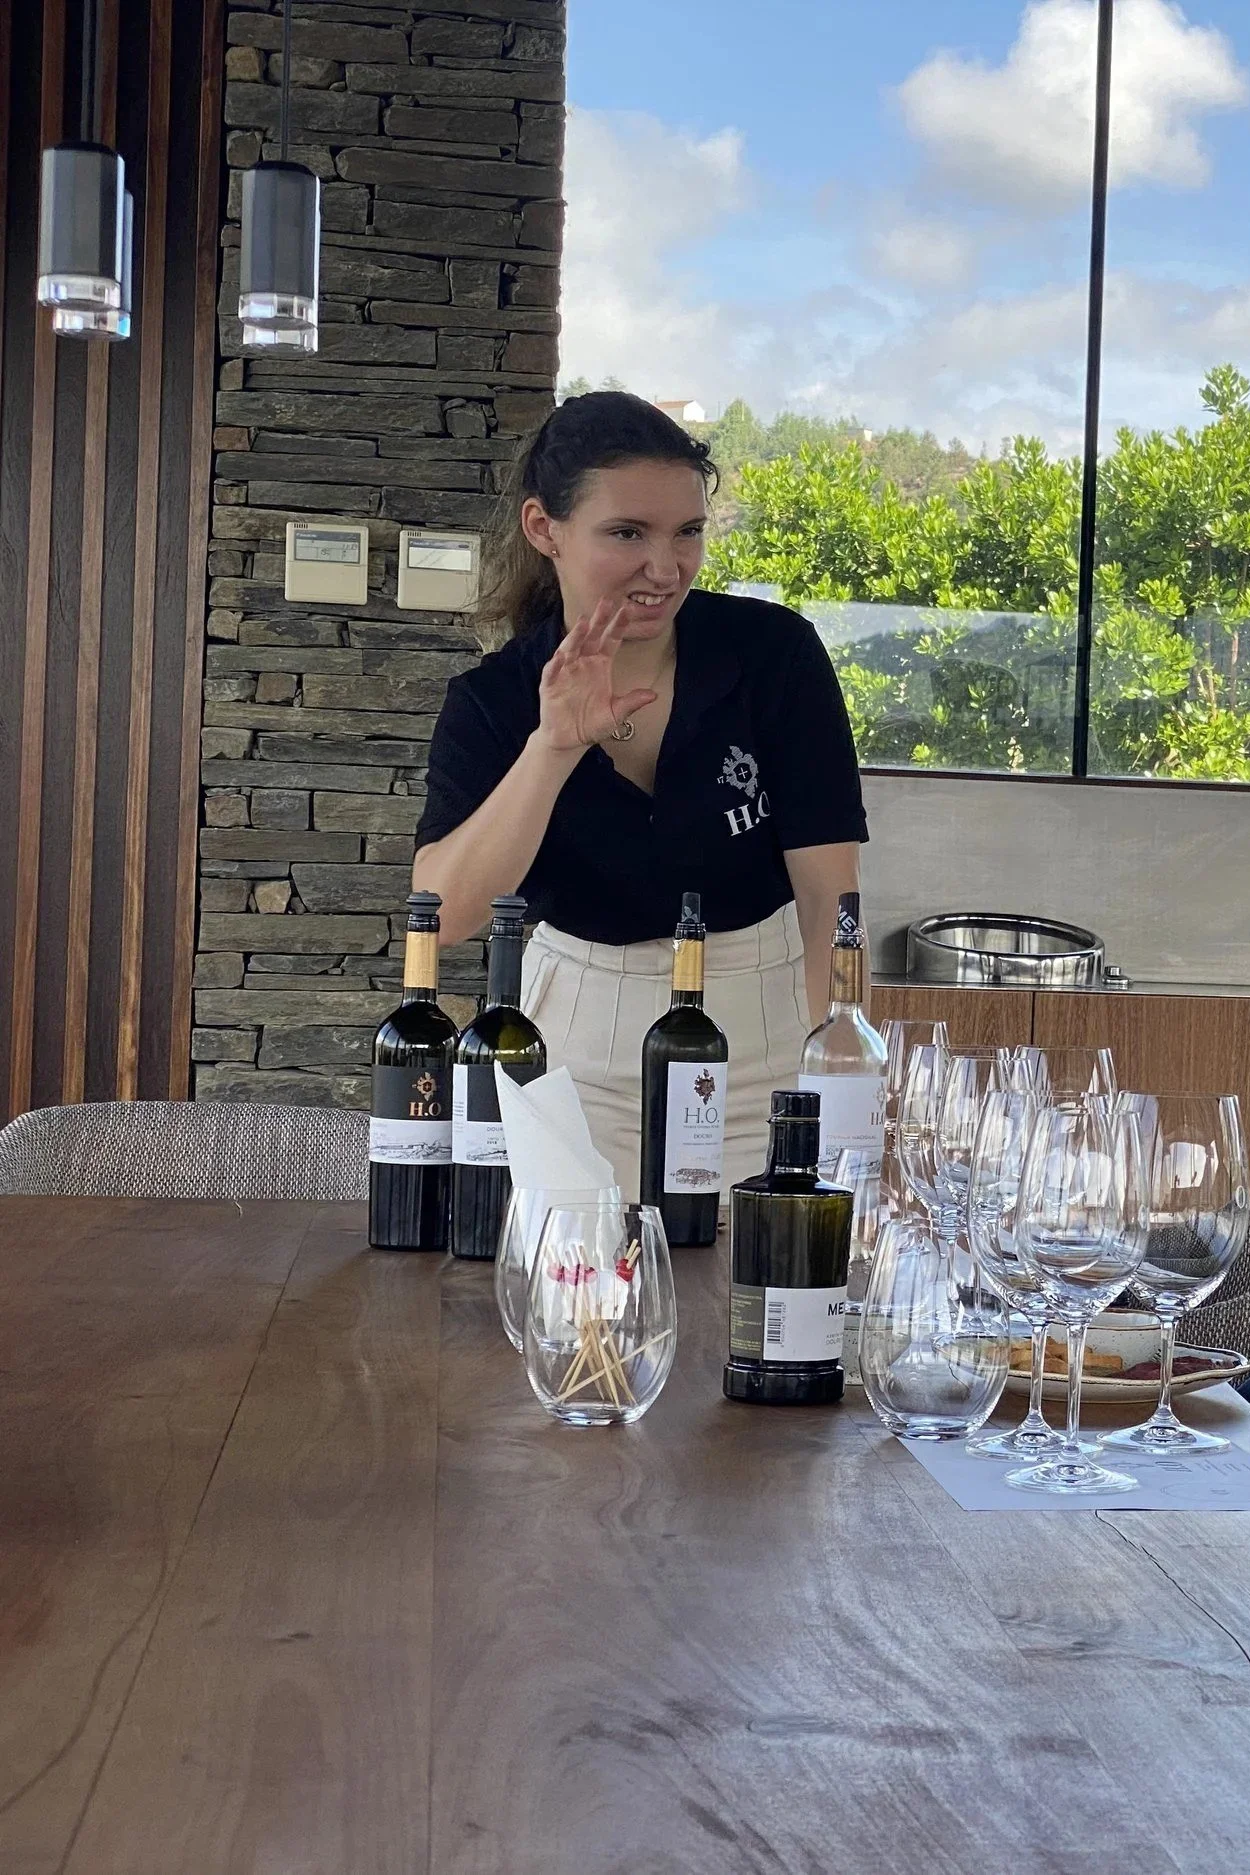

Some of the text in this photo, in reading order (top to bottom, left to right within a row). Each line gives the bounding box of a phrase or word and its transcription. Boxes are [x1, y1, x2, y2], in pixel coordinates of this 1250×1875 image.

[409, 1102, 442, 1117] H.O
[684, 1107, 720, 1124] H.O.
[826, 1301, 845, 1316] ME
